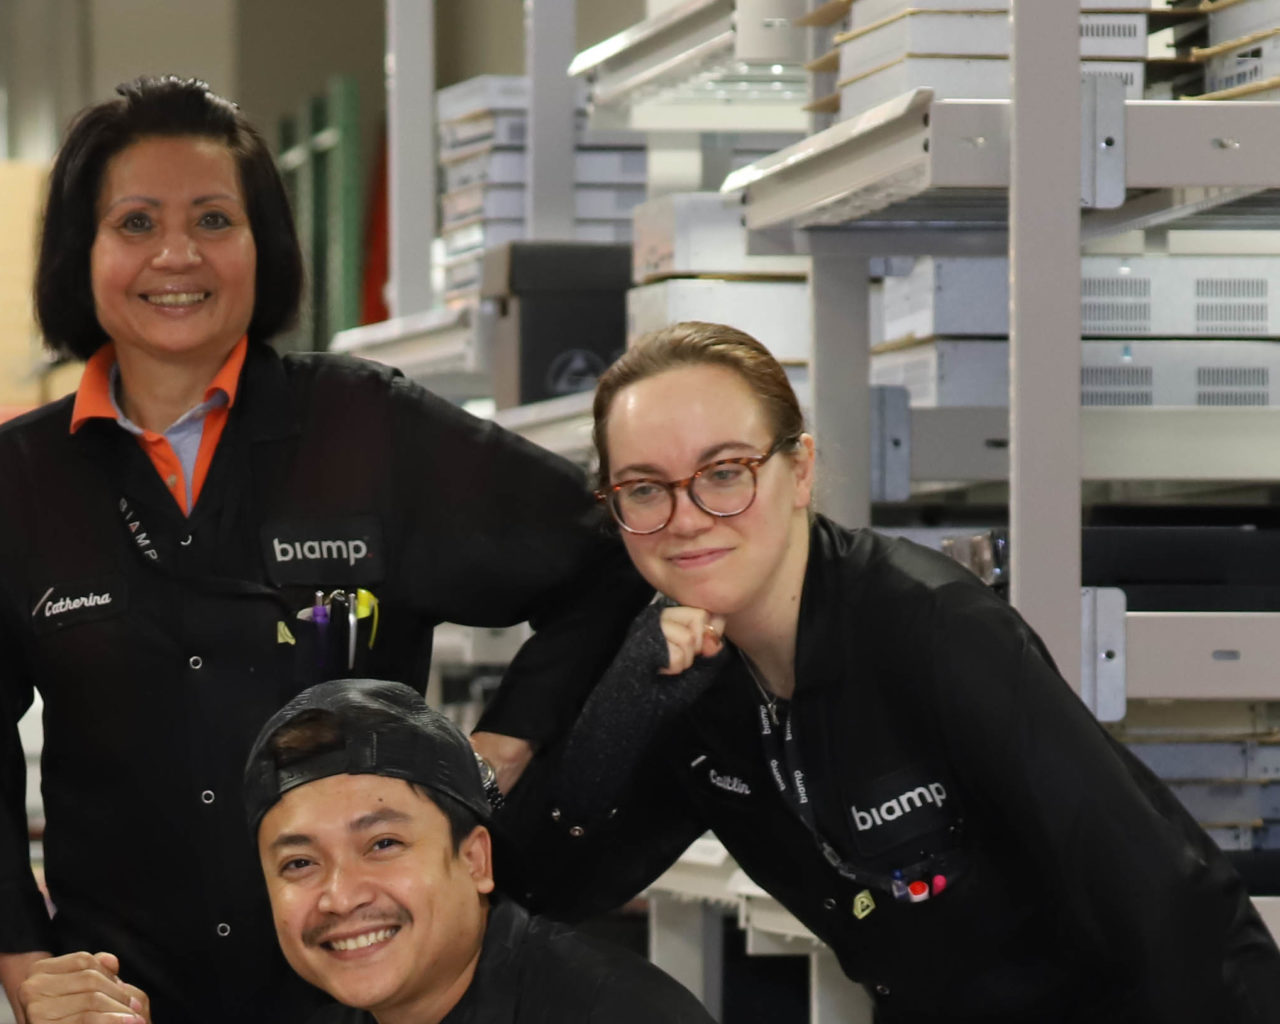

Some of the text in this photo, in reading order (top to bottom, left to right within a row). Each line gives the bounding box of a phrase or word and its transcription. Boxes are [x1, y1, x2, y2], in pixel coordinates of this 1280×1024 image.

[44, 592, 112, 617] Catherina
[709, 769, 752, 795] Caitlin
[851, 782, 947, 832] biamp
